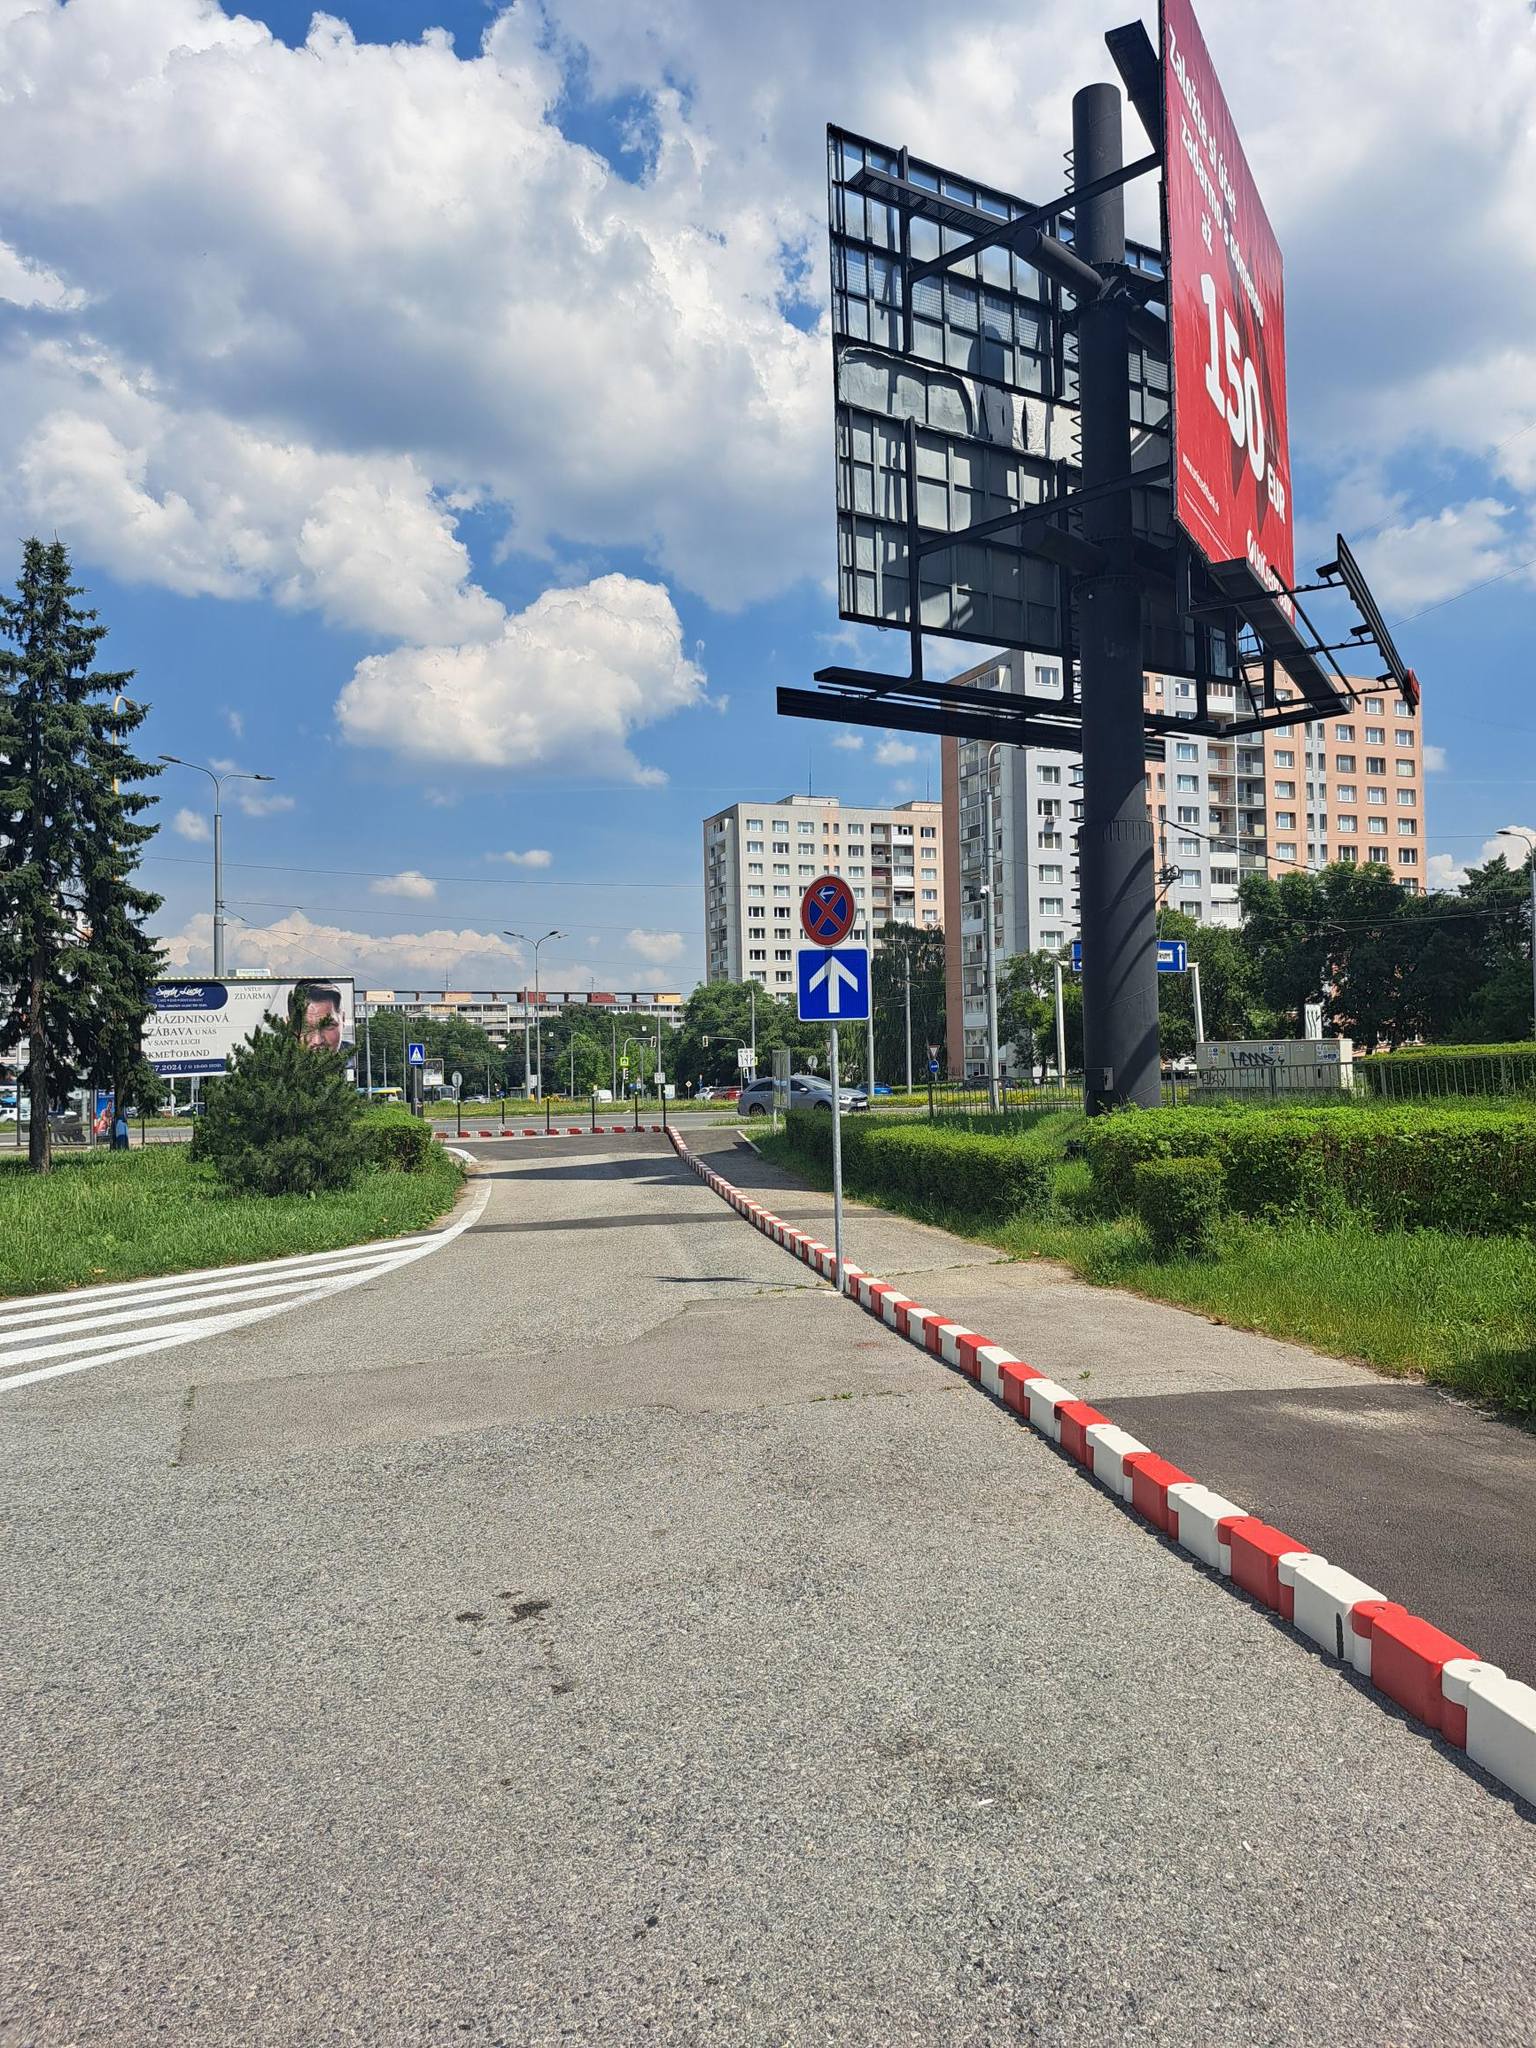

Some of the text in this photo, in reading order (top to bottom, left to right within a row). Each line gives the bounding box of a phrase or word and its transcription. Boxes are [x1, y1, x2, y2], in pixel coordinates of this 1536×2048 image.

[1169, 23, 1237, 222] Založte si účet
[1181, 113, 1223, 230] zadarmo
[1223, 217, 1229, 247] s
[1201, 210, 1213, 255] až
[1200, 273, 1265, 482] 150
[1267, 462, 1286, 525] EUR
[234, 992, 272, 1000] ZDARMA
[148, 1012, 230, 1024] PRÁZDNINOVÁ
[148, 1026, 193, 1037] ZÁBAVA
[148, 1049, 210, 1059] KMEŤOBAND
